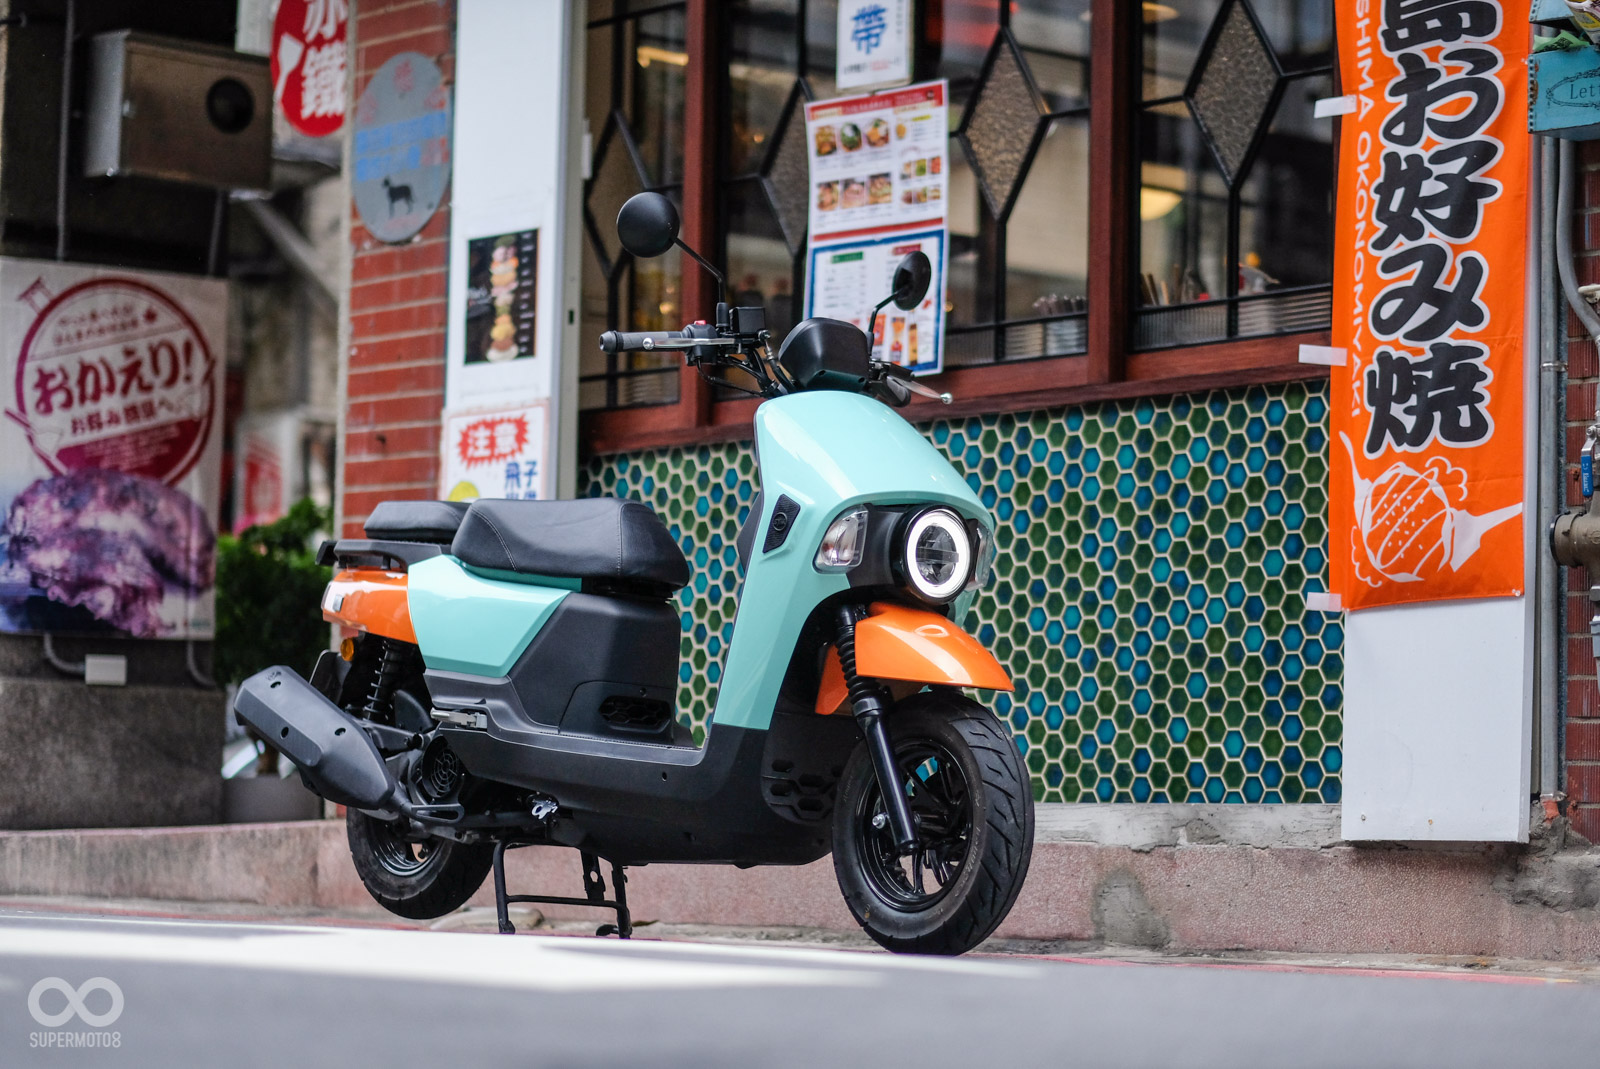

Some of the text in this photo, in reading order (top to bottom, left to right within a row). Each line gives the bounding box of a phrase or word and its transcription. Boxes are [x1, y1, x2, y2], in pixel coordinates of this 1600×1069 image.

[1570, 83, 1600, 100] Let
[1351, 130, 1372, 418] OKONOMIYAKI
[33, 339, 194, 416] おかえり!
